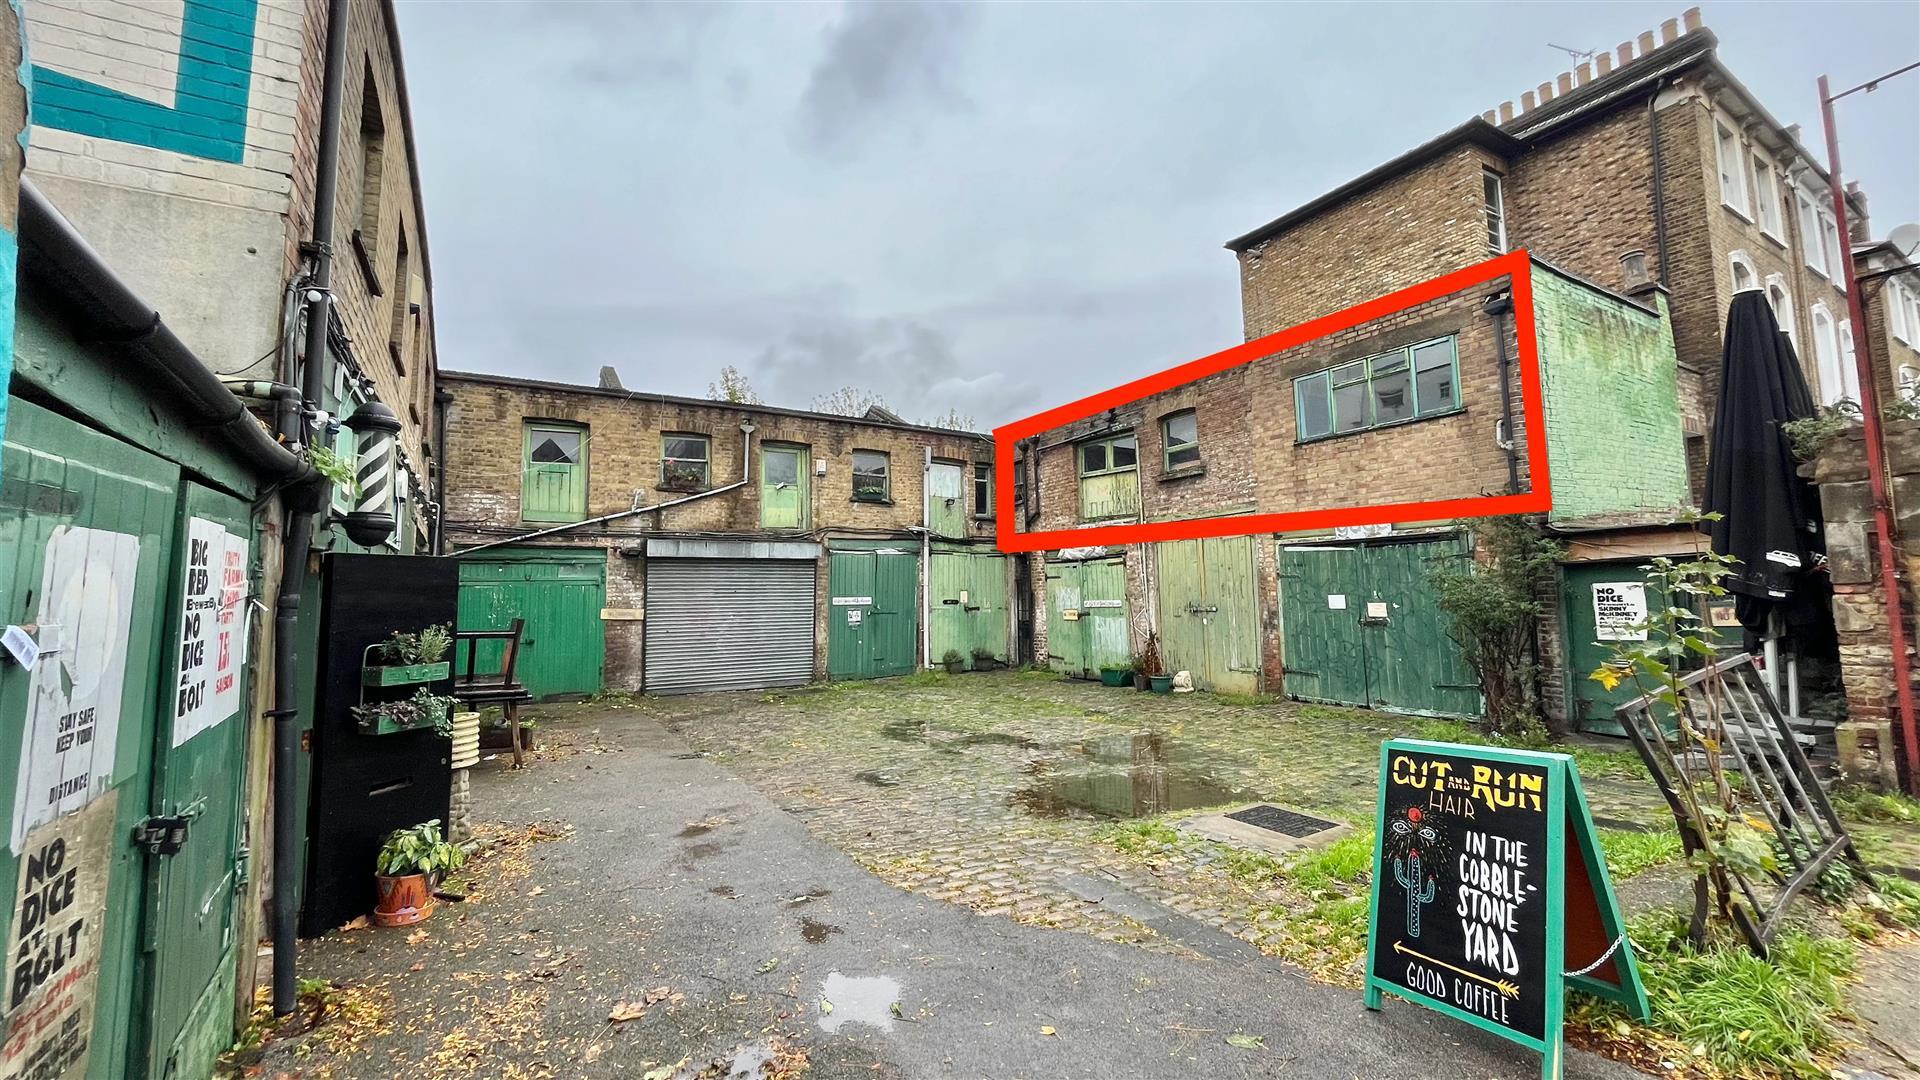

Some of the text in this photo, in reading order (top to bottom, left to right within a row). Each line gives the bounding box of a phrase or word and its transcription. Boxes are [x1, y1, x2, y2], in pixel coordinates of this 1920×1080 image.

[191, 538, 208, 566] BIG
[188, 568, 209, 596] RED
[184, 612, 201, 641] NO
[181, 640, 204, 672] DICE
[177, 680, 206, 718] BOLT
[59, 706, 95, 733] STAY SAFE
[56, 726, 93, 754] KEEP YOUR
[49, 772, 88, 805] DISTANCE
[1393, 756, 1543, 812] CUT AND RUN
[1429, 791, 1475, 820] HAIR
[25, 838, 65, 895] NO
[1465, 830, 1529, 867] IN THE
[1459, 853, 1538, 904] COBBLE-
[19, 866, 78, 941] DICE
[1457, 885, 1519, 933] STONE
[12, 918, 84, 1010] BOLT
[16, 929, 45, 964] AT
[1462, 919, 1519, 977] YARD
[1406, 961, 1509, 1026] GOOD COFFEE
